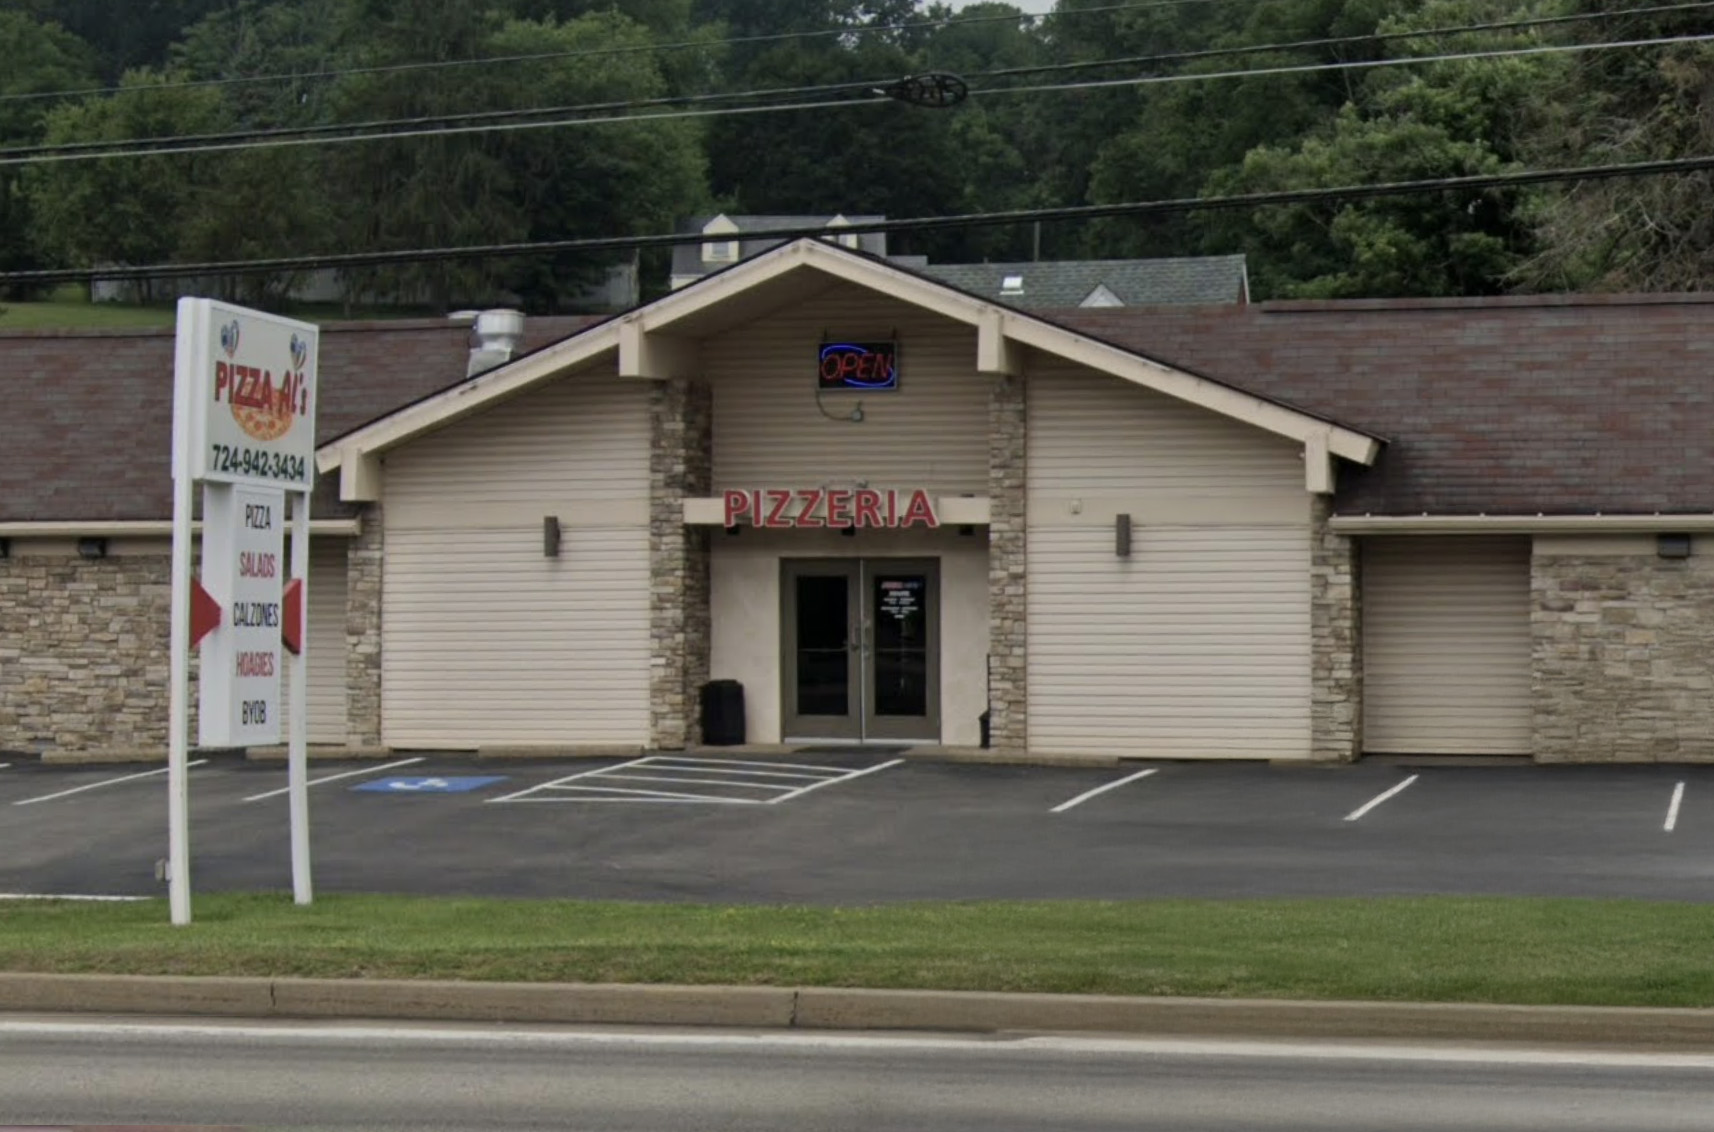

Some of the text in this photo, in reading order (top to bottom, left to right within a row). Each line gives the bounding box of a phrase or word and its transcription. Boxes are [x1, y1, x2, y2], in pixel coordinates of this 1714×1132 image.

[821, 352, 893, 379] OPEN
[215, 360, 273, 411] PIZZA
[213, 444, 305, 480] 724-942-3434
[245, 503, 271, 530] PIZZA
[722, 488, 940, 528] PIZZERIA
[239, 551, 276, 578] SALADS
[233, 602, 279, 628] CALZONES
[235, 651, 274, 677] HOAGIES
[242, 700, 266, 725] BYOB
